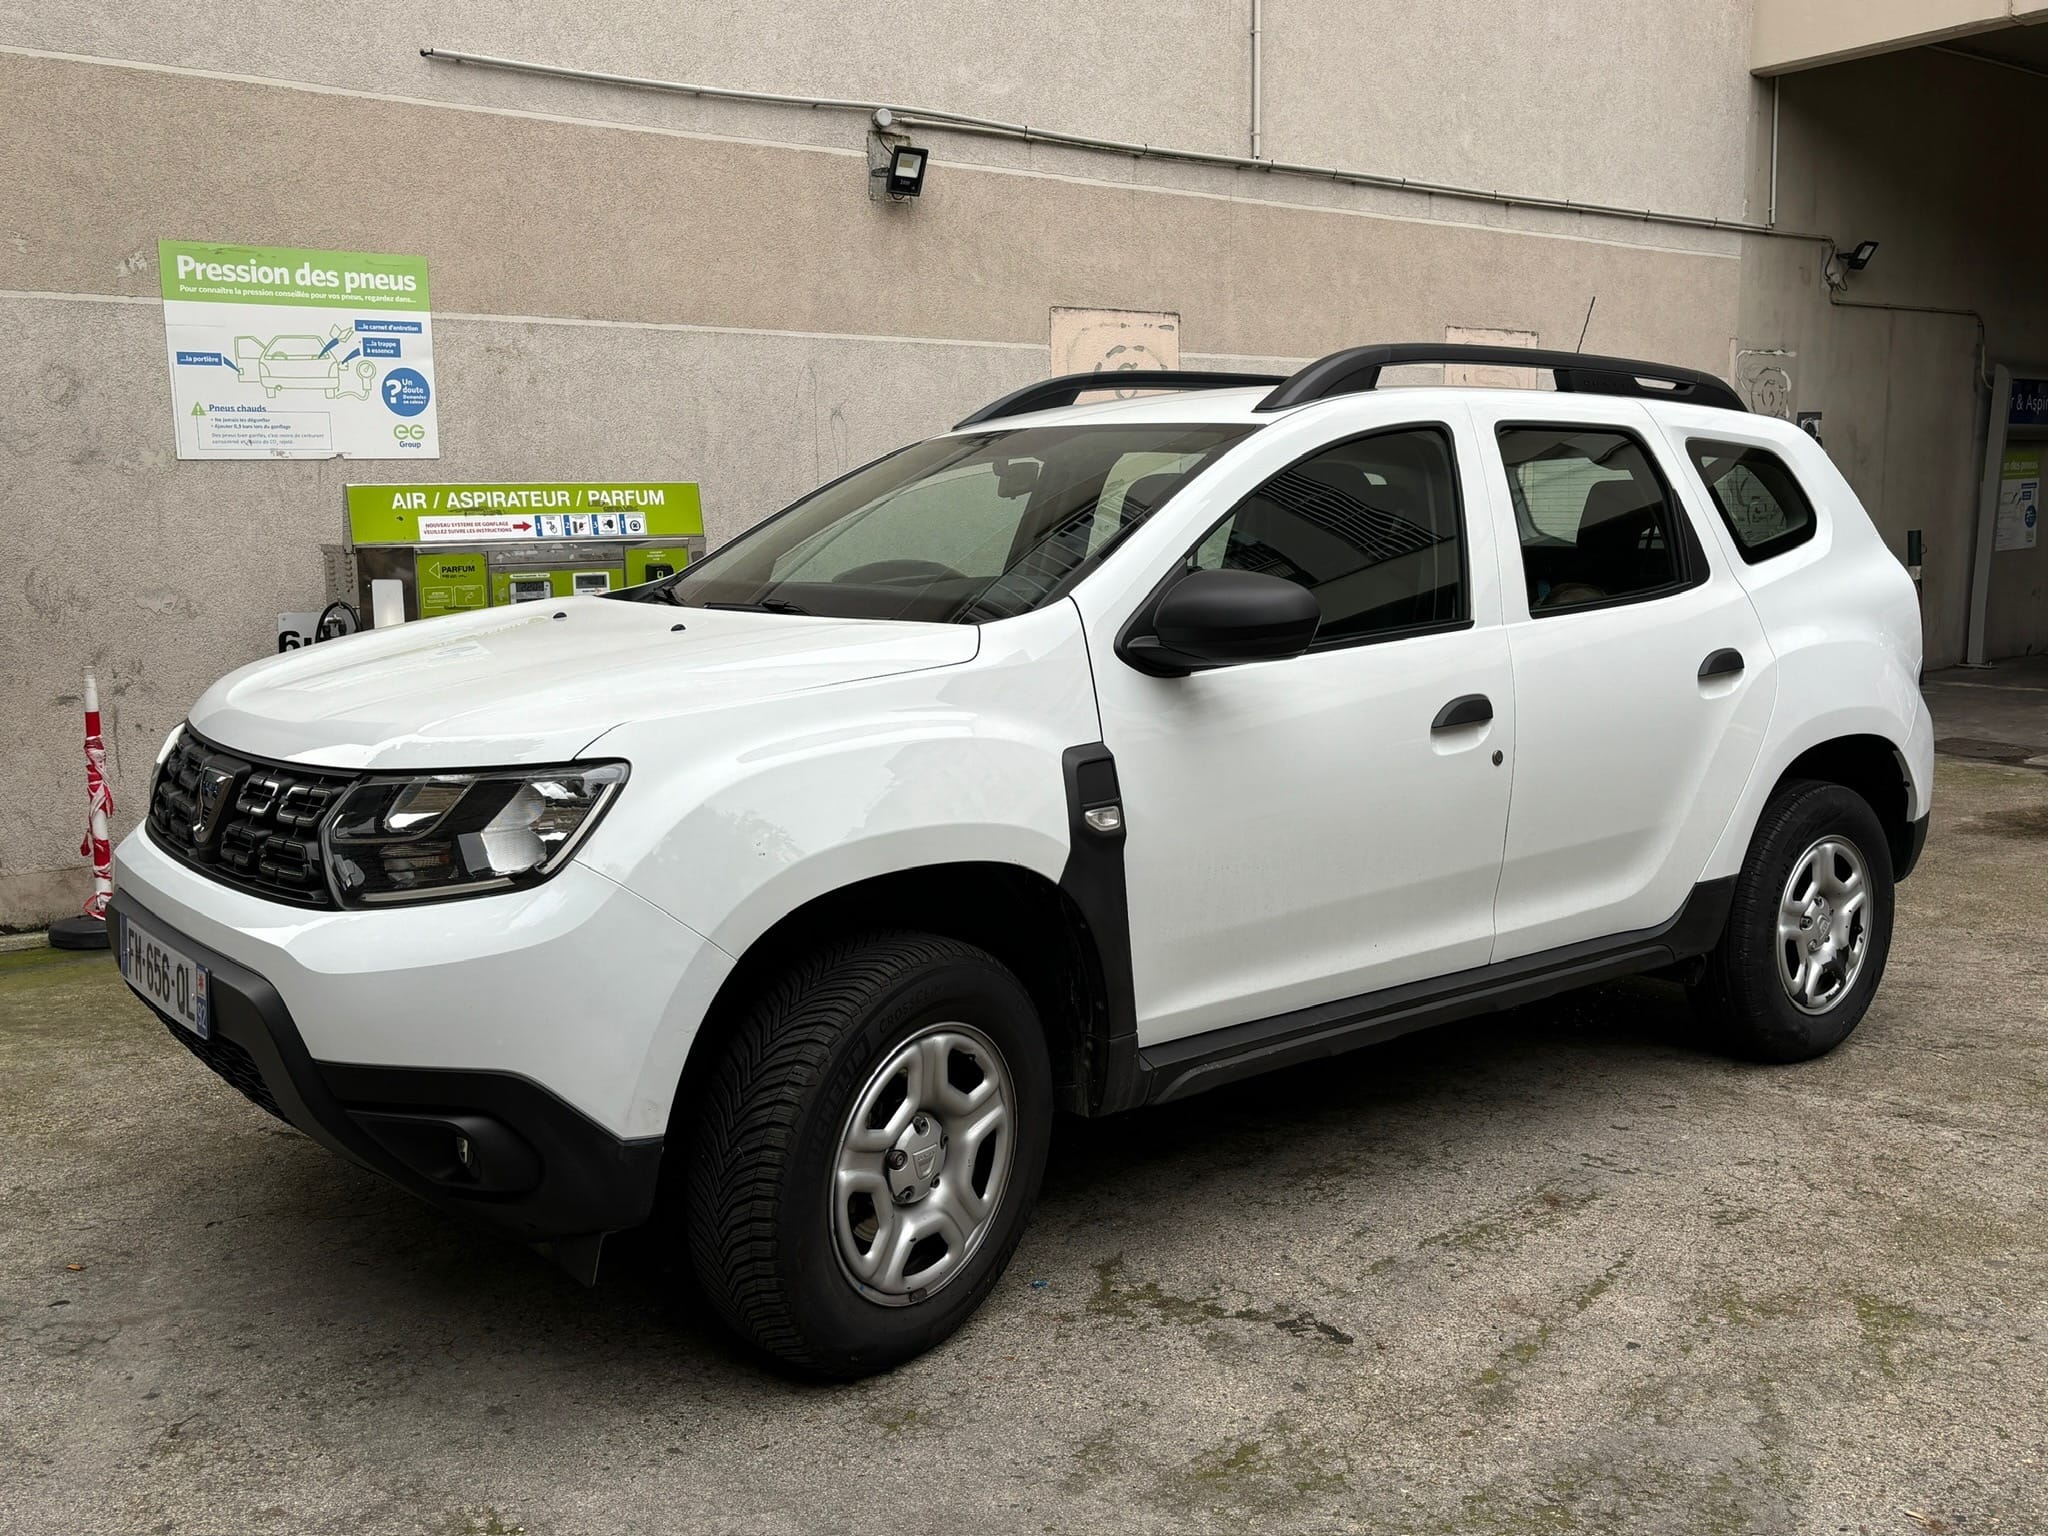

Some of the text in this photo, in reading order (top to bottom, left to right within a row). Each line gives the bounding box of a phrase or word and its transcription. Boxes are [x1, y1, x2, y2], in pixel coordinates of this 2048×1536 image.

[177, 255, 417, 293] Pression des pneus
[180, 284, 197, 292] Pour
[234, 287, 242, 295] la
[243, 288, 274, 297] pression
[377, 340, 397, 349] trappe
[193, 354, 219, 363] portière
[402, 378, 413, 386] Un
[402, 385, 424, 394] doute
[209, 403, 267, 413] Pneus chauds
[392, 489, 665, 509] AIR / ASPIRATEUR / PARFUM
[442, 565, 475, 573] PARFUM
